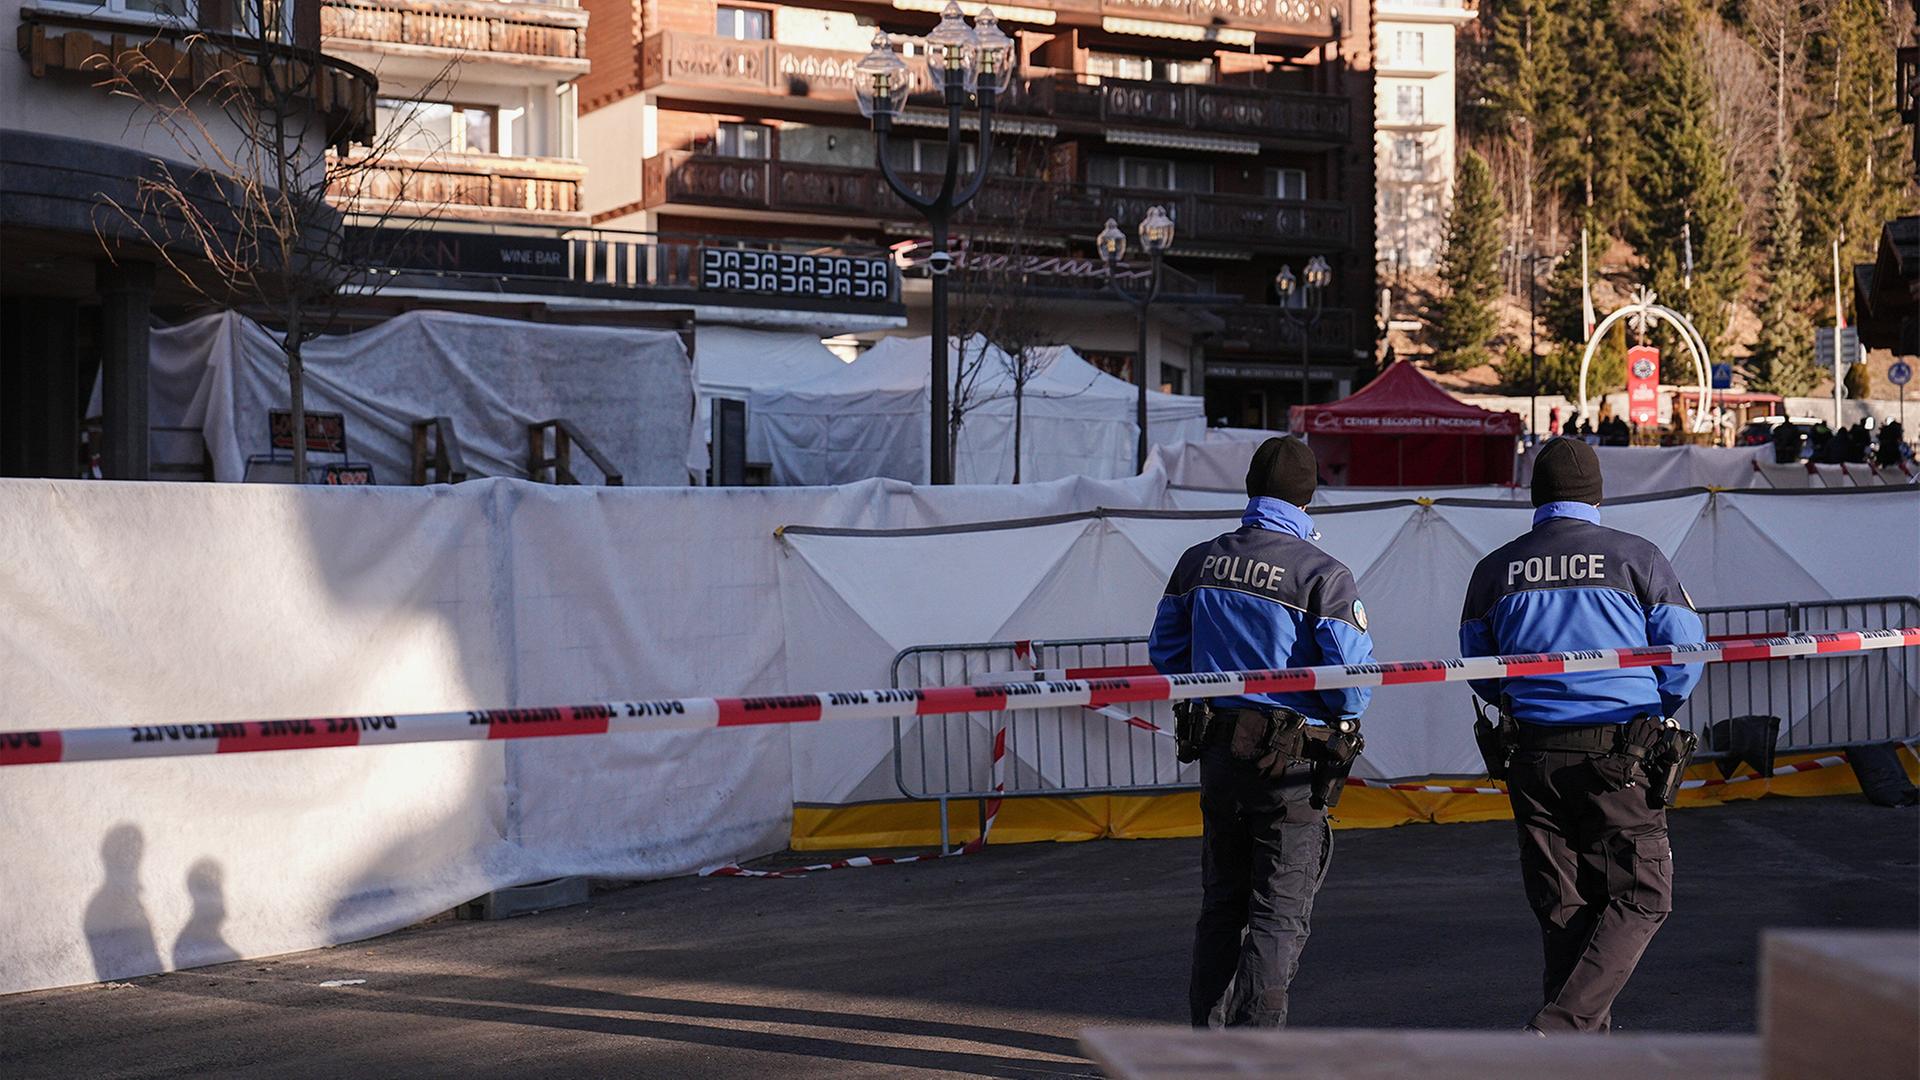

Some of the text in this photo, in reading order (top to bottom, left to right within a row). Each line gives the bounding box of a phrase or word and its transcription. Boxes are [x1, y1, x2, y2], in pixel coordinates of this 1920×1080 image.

[501, 249, 561, 265] WINE BAR
[1344, 416, 1379, 427] CENTRE
[1381, 416, 1422, 427] SECOURS
[1424, 417, 1437, 427] ET
[1438, 417, 1482, 427] INCENDIE
[1199, 555, 1286, 592] POLICE
[1507, 553, 1605, 585] POLICE
